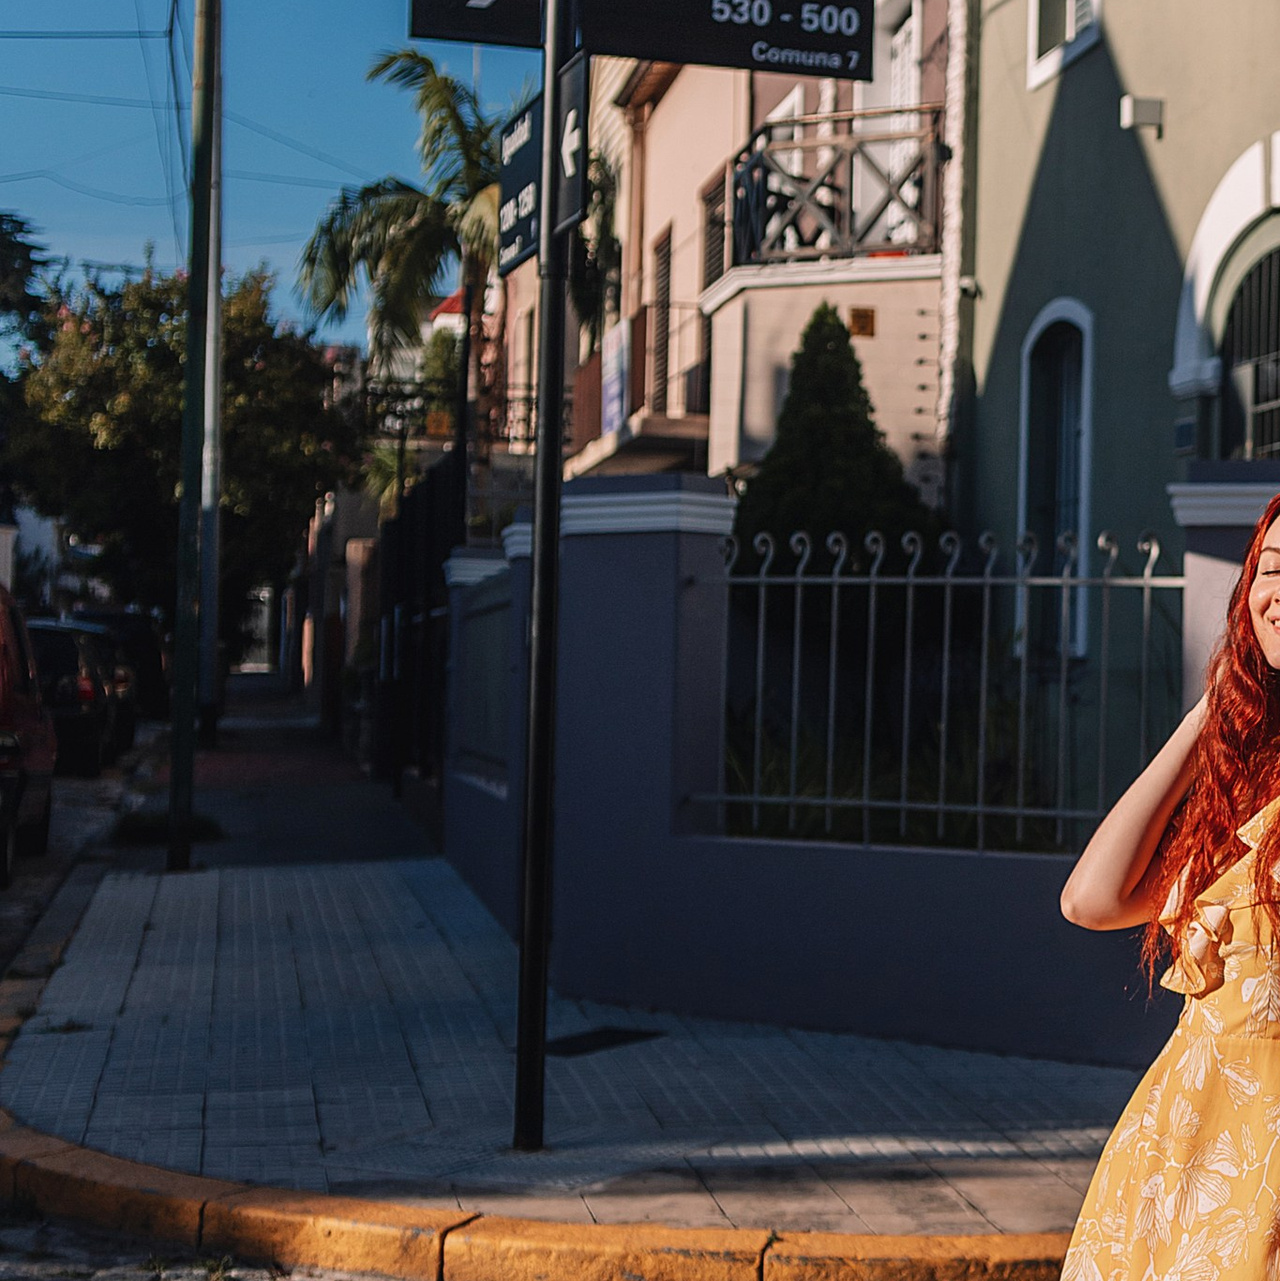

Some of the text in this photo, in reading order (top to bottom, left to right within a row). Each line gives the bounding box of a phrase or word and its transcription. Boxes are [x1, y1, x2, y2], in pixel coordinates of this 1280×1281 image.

[800, 2, 860, 37] 500
[751, 40, 860, 70] Comuna 7
